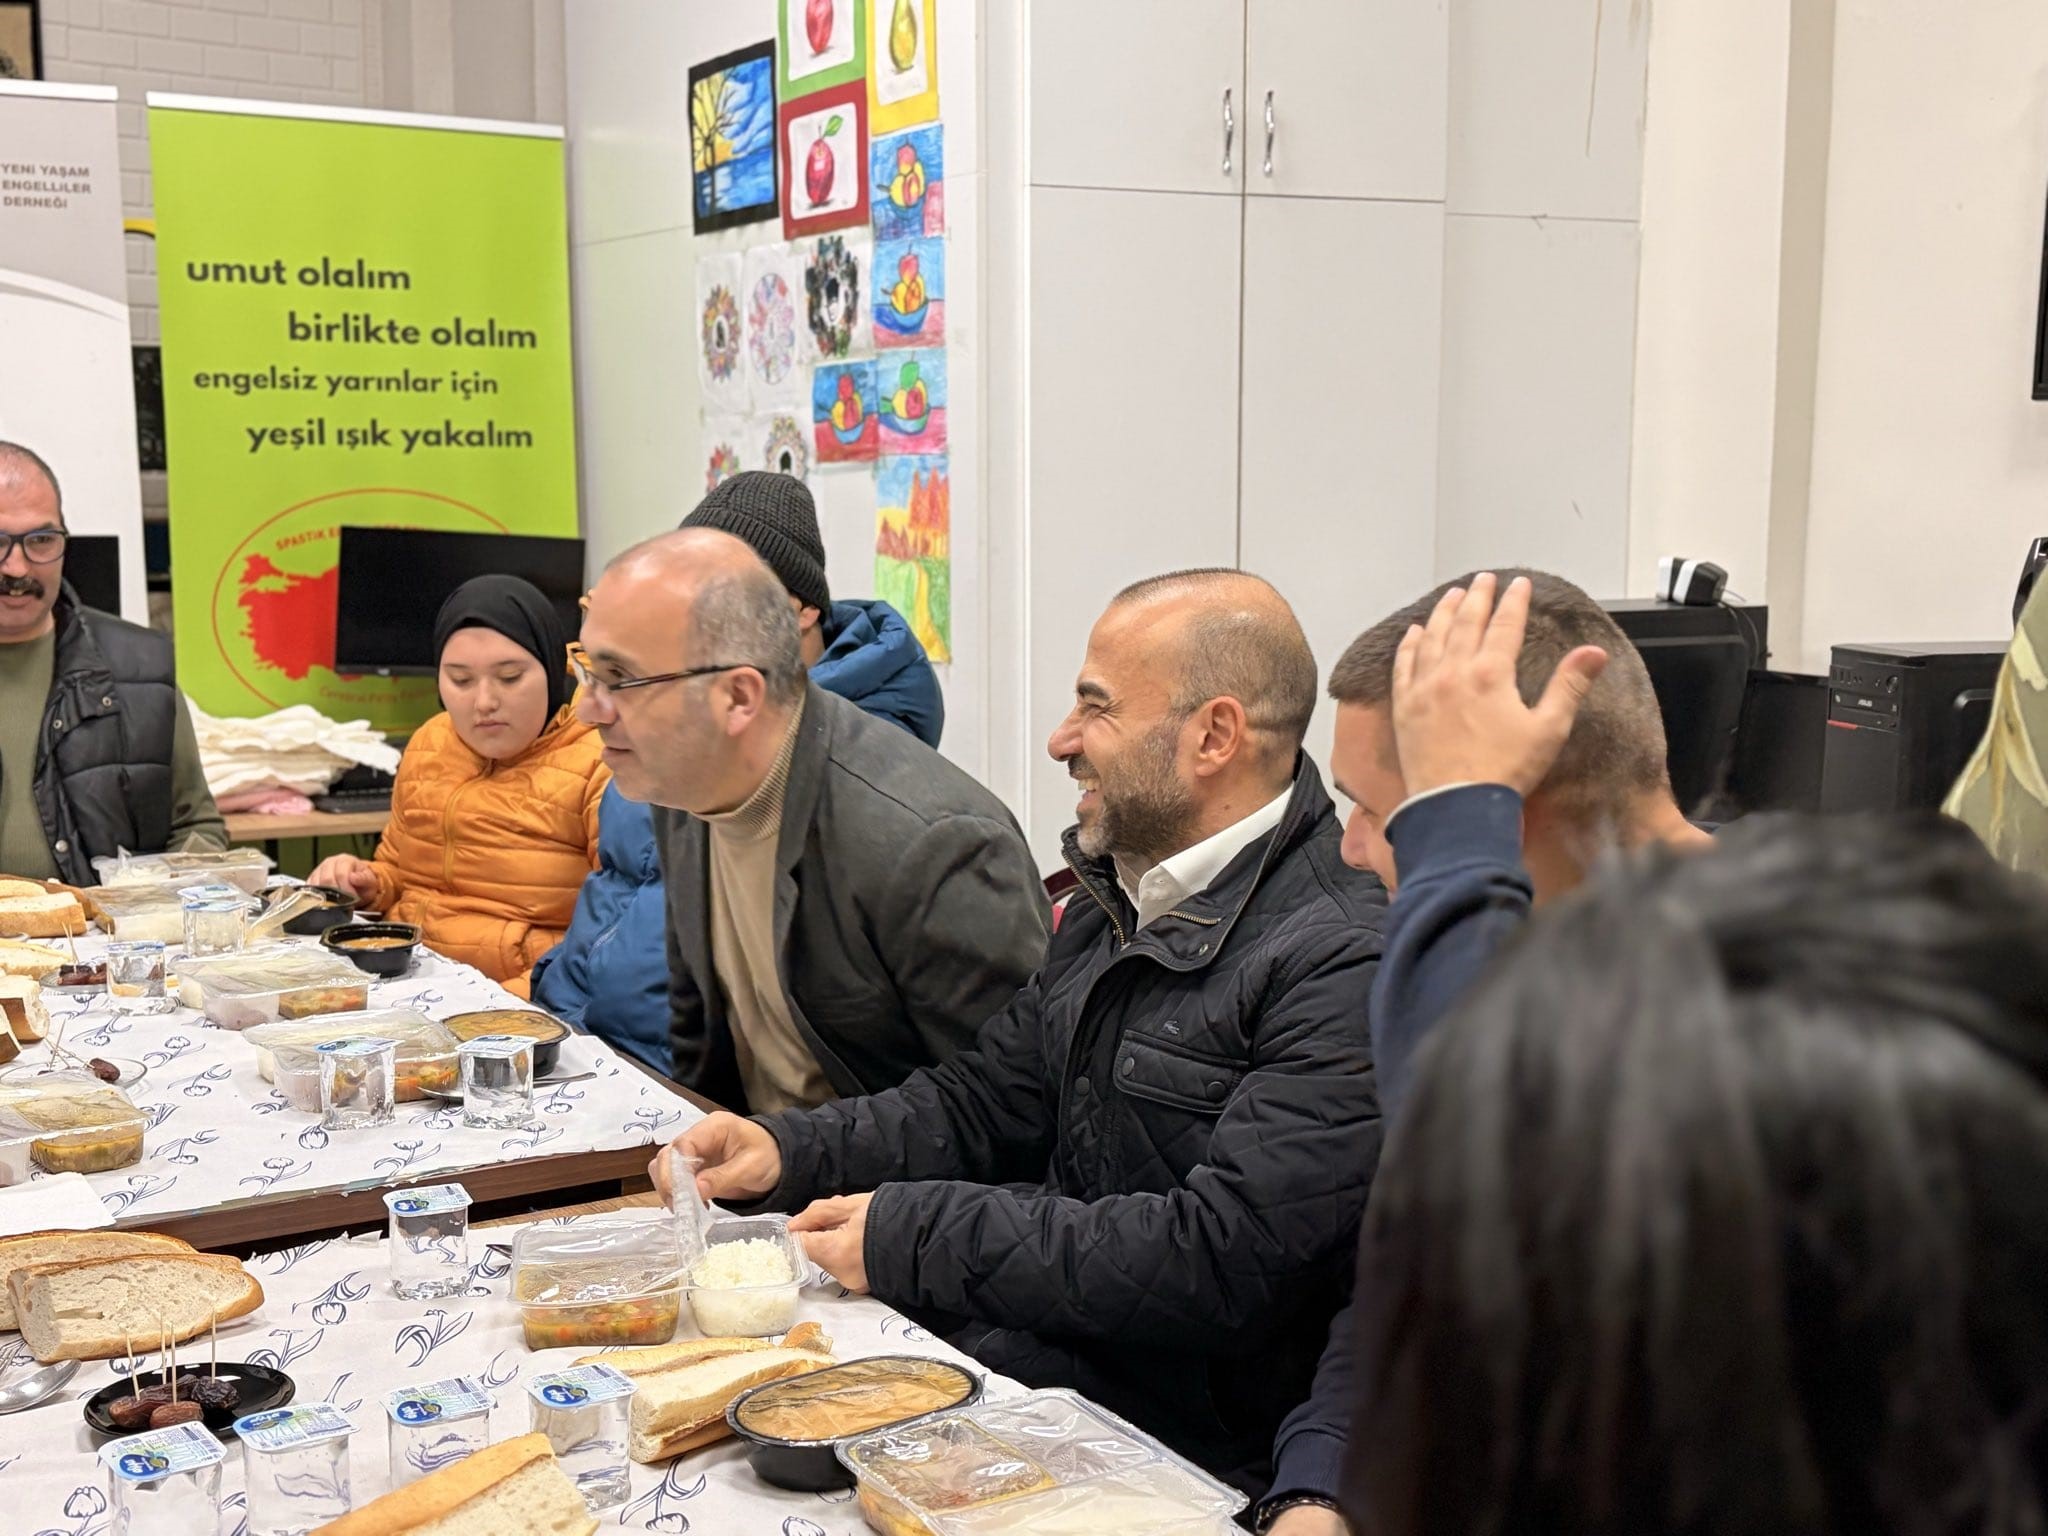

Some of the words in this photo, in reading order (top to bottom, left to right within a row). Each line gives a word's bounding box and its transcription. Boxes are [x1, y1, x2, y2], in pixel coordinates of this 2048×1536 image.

[40, 165, 90, 178] YAŞAM
[187, 260, 287, 285] umut
[297, 256, 411, 290] olalım
[288, 310, 421, 345] birlikte
[430, 317, 537, 349] olalım
[193, 365, 318, 396] engelsiz
[325, 368, 443, 397] yarınlar
[451, 371, 499, 400] için
[246, 418, 326, 454] yeşil
[336, 418, 392, 451] ışık
[400, 419, 533, 455] yakalım
